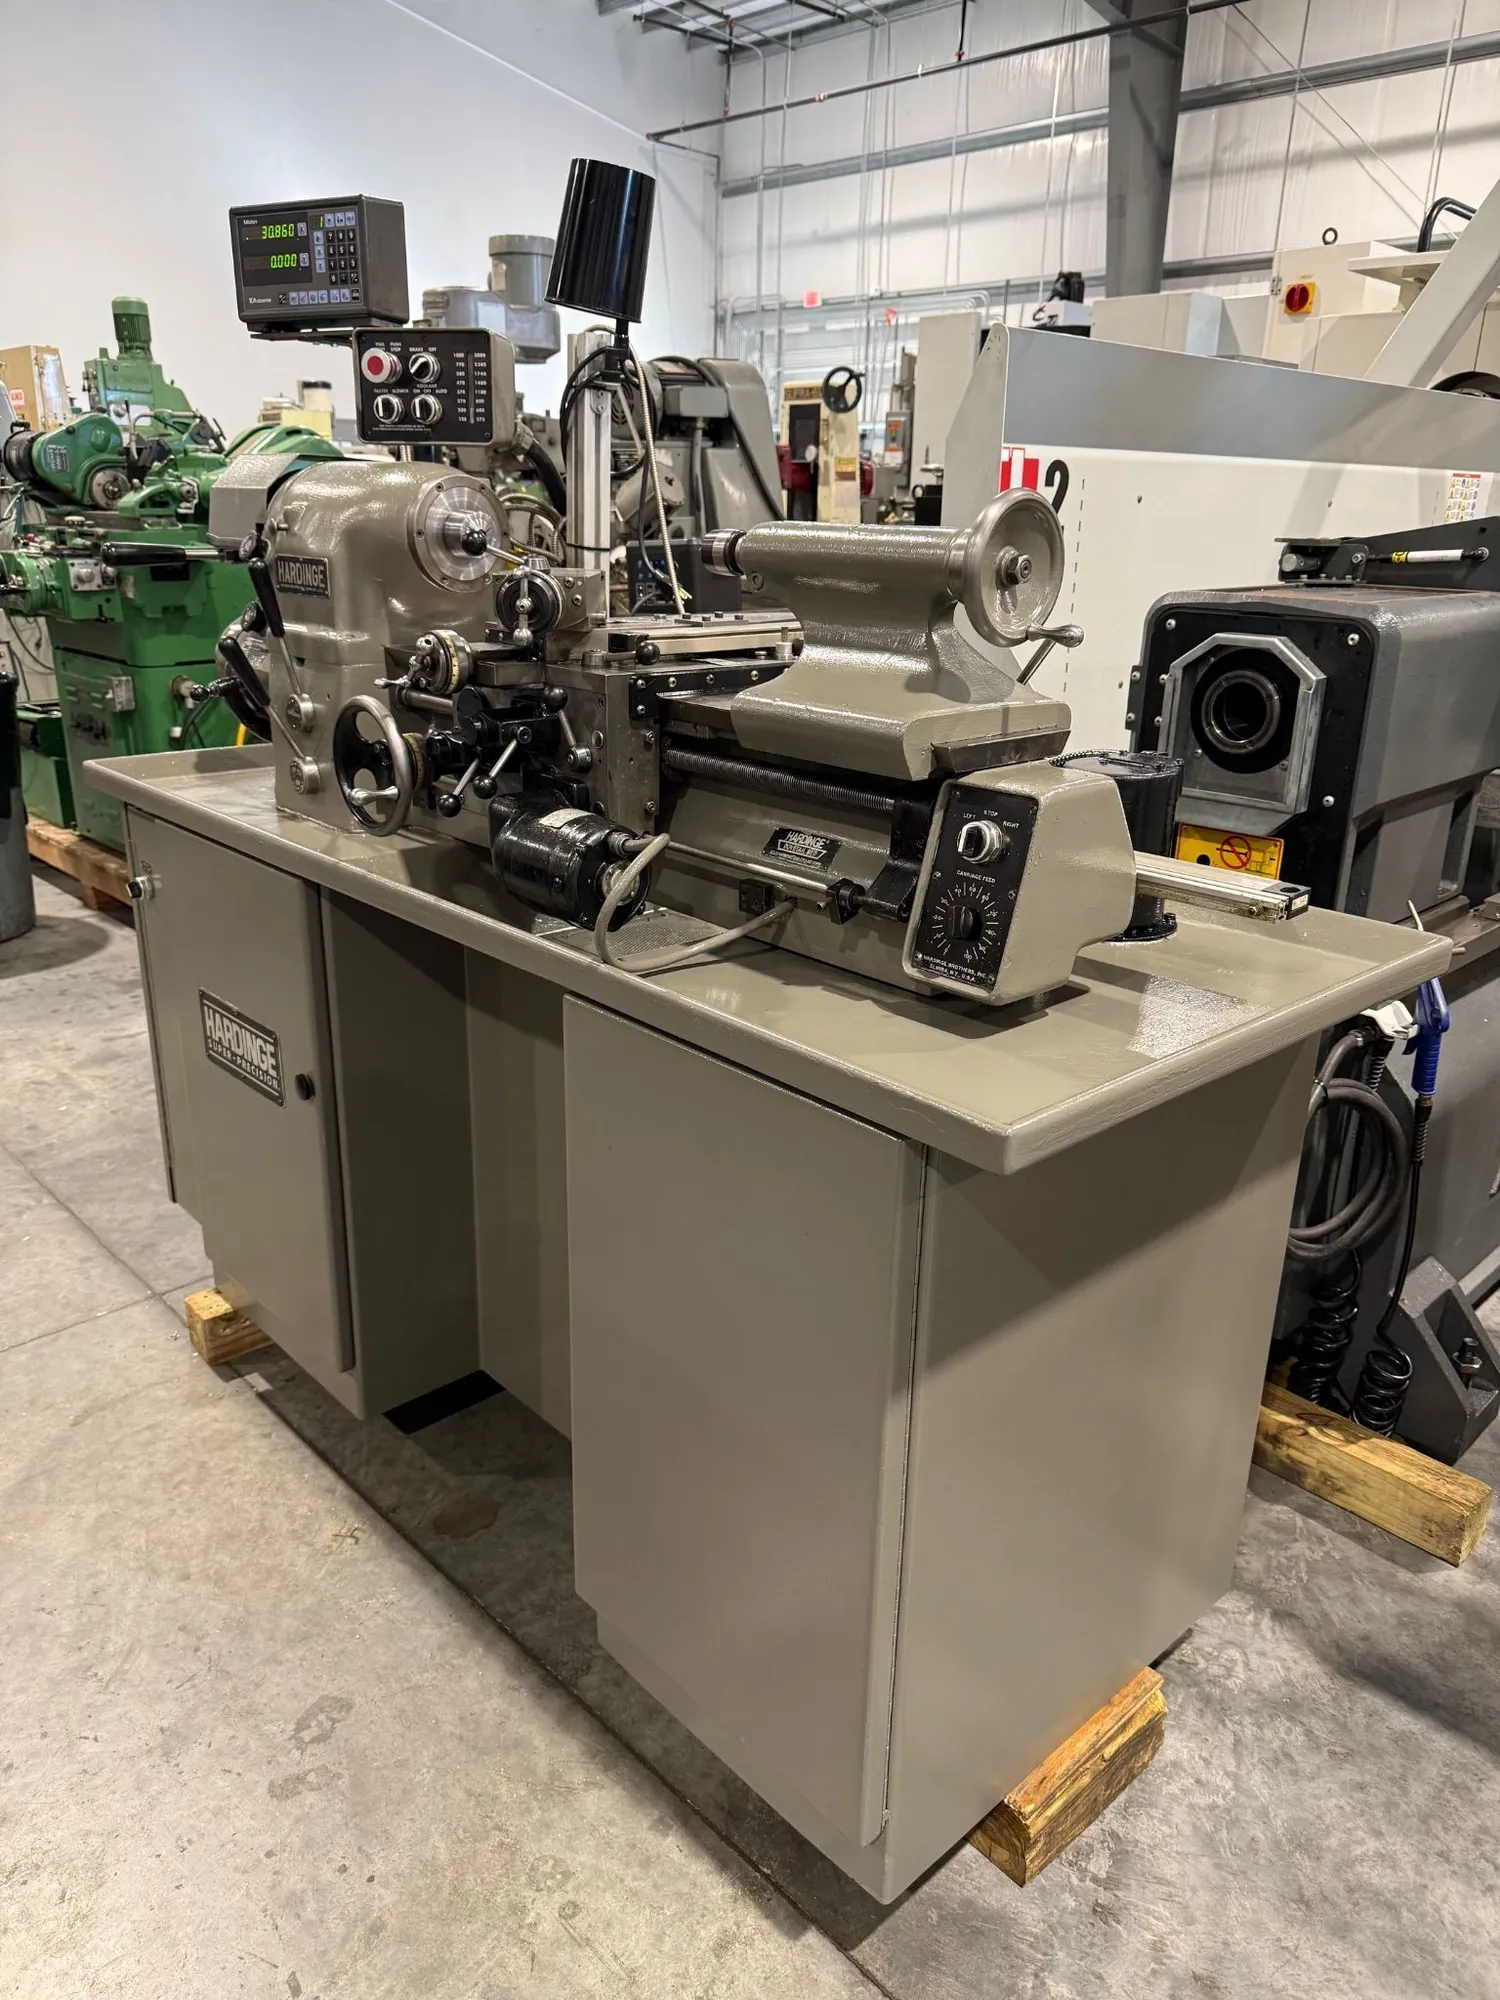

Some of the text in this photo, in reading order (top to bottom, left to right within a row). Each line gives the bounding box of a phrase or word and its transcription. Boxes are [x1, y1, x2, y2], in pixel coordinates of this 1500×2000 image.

[270, 253, 297, 269] 0.000
[277, 560, 326, 588] HARDINGE
[963, 812, 976, 820] LEFT
[983, 809, 998, 817] STOP
[1003, 820, 1020, 828] RIGHT
[786, 831, 827, 849] HARDINGE
[956, 869, 996, 884] CARRIAGE FEED
[923, 955, 948, 967] HARDINGE
[204, 1006, 278, 1077] HARDINGE
